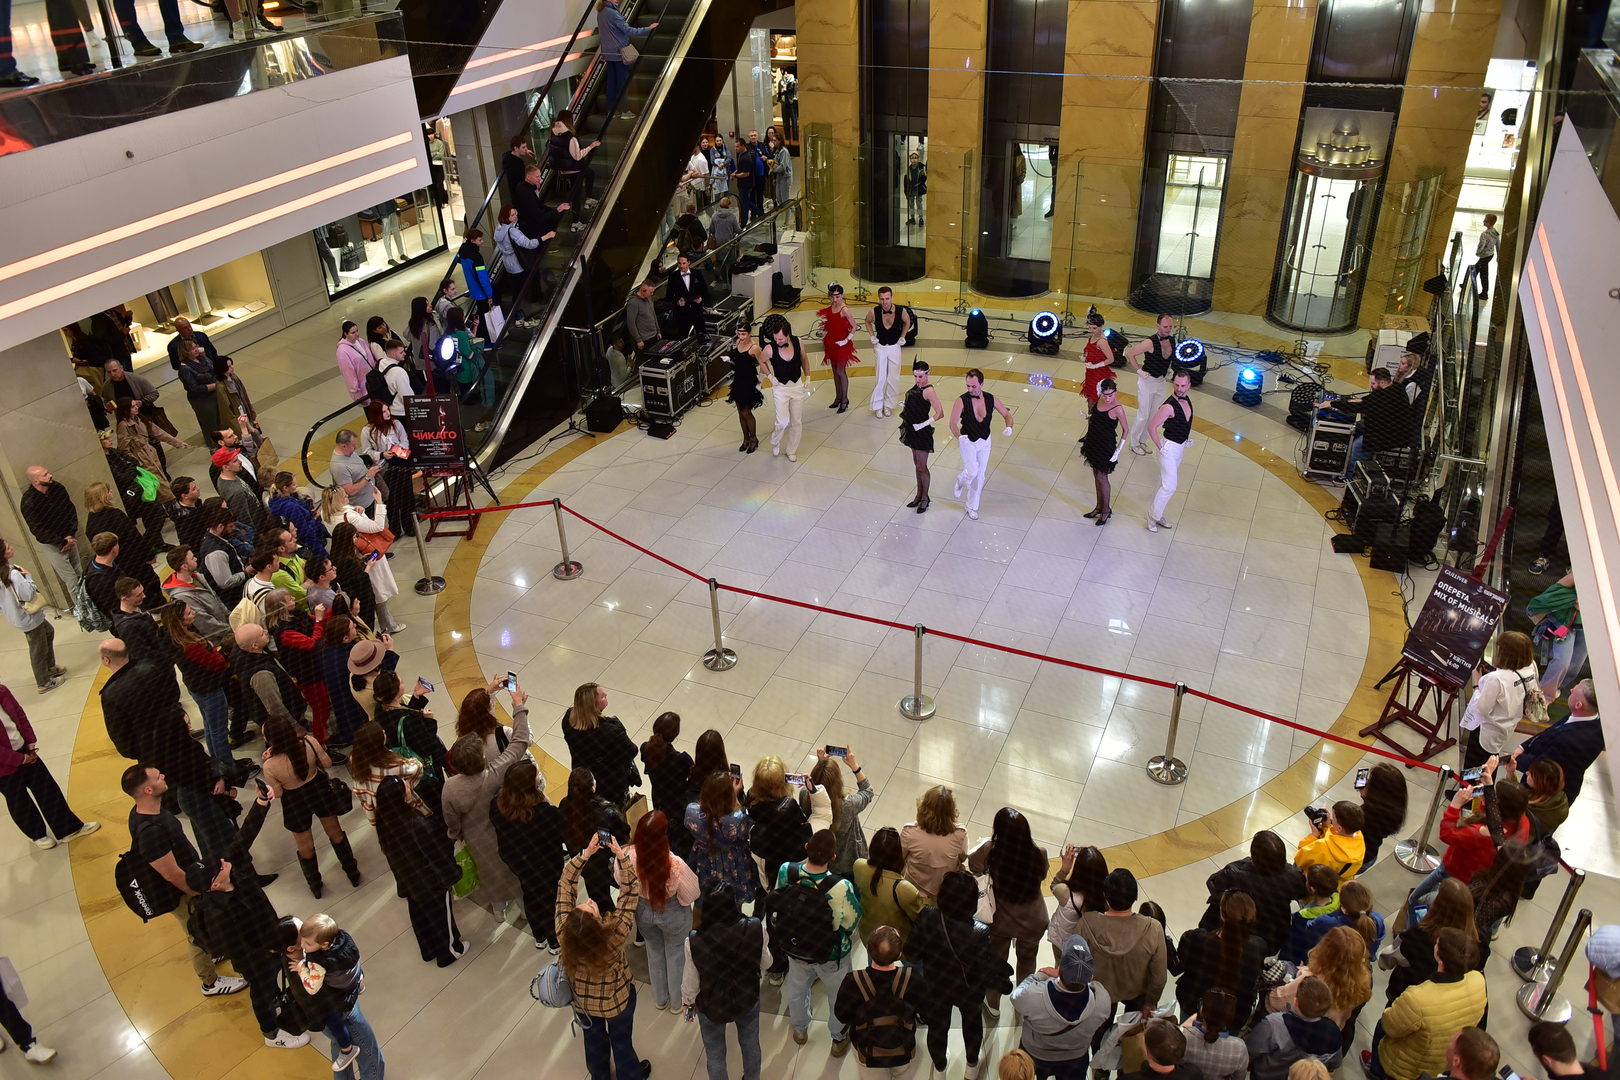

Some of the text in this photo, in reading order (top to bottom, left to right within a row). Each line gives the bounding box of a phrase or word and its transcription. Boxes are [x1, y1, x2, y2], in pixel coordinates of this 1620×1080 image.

[412, 430, 457, 440] ЧИКАГО
[1437, 581, 1471, 603] ОПЕРЕТА.
[1433, 589, 1495, 626] MIX OF MUSICALS
[1452, 655, 1472, 669] КВІТНЯ
[134, 888, 154, 916] Reebok
[275, 1039, 287, 1047] ck
